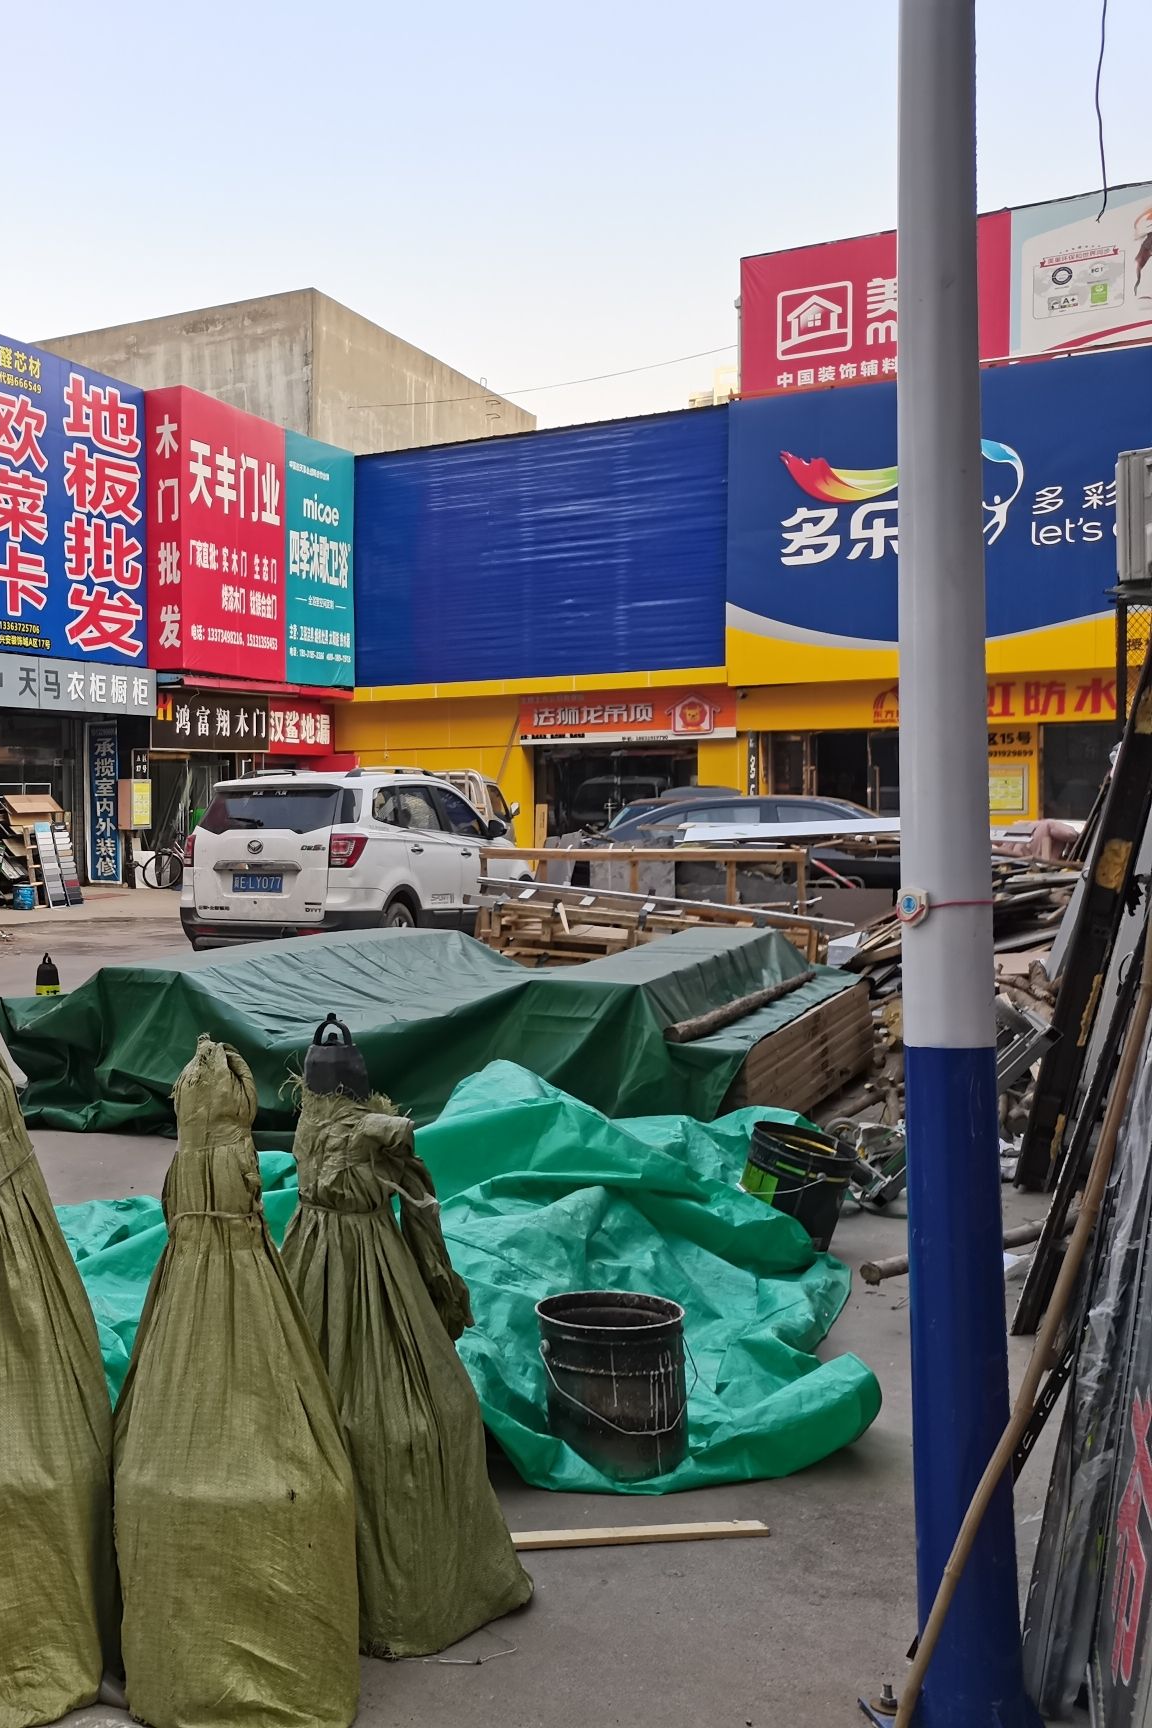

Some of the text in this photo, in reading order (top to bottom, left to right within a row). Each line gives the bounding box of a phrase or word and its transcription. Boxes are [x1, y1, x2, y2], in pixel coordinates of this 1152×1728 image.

[188, 439, 282, 527] 天丰门业
[62, 371, 144, 658] 地板批发
[303, 493, 340, 527] micoe
[155, 414, 182, 650] 木门批发
[780, 499, 899, 567] 多乐
[1031, 516, 1103, 546] let's
[18, 666, 149, 706] 天马衣柜橱柜
[175, 704, 267, 739] 鸿富翔木门
[269, 709, 331, 746] 汉鲨地漏
[533, 702, 654, 727] 法狮龙吊顶
[94, 737, 117, 877] 承揽室内外装修
